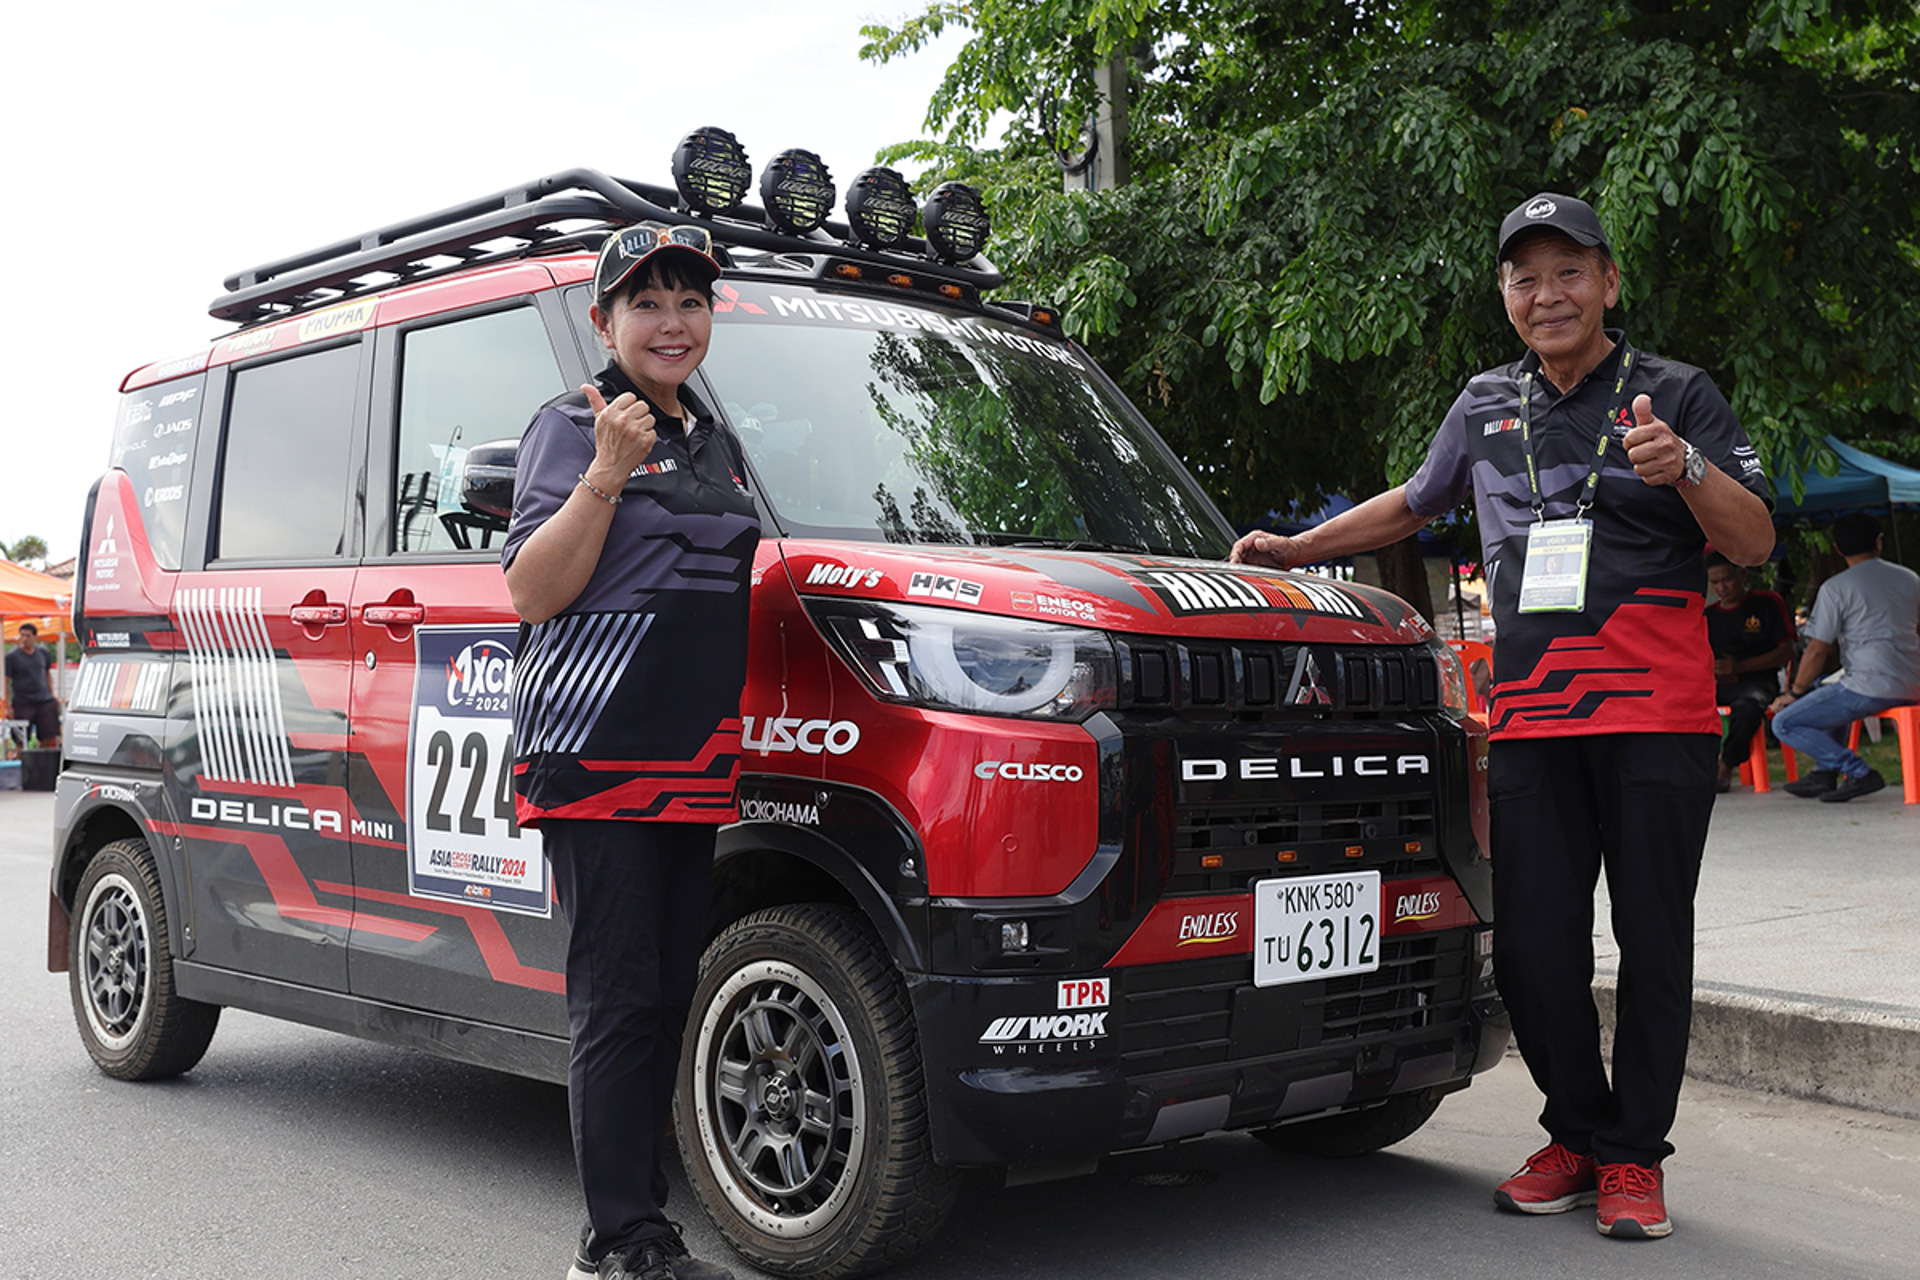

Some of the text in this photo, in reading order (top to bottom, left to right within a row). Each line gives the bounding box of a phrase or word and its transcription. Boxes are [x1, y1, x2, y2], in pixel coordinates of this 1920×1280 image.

[769, 295, 1086, 372] MITSUBISHI MOTORS
[805, 563, 882, 589] Moty's
[911, 574, 980, 598] HKS
[1036, 594, 1096, 613] ENEOS
[1149, 572, 1364, 619] RALLIART
[1039, 606, 1097, 621] MOTOR OIL
[475, 697, 508, 711] 2024
[741, 716, 860, 754] USCO
[1182, 755, 1429, 781] DELICA
[426, 729, 521, 839] 224
[191, 798, 394, 840] DELICA MINI
[740, 799, 820, 825] YOKOHAMA
[430, 849, 452, 869] ASIA
[472, 855, 503, 873] RALLY
[502, 859, 525, 877] 2024
[1285, 881, 1354, 914] KNK 580
[1395, 892, 1441, 917] ENDLESS
[1178, 912, 1239, 939] ENDLESS
[1263, 913, 1375, 973] TU 6312
[1062, 981, 1106, 1006] TPR
[1029, 1012, 1109, 1039] WORK
